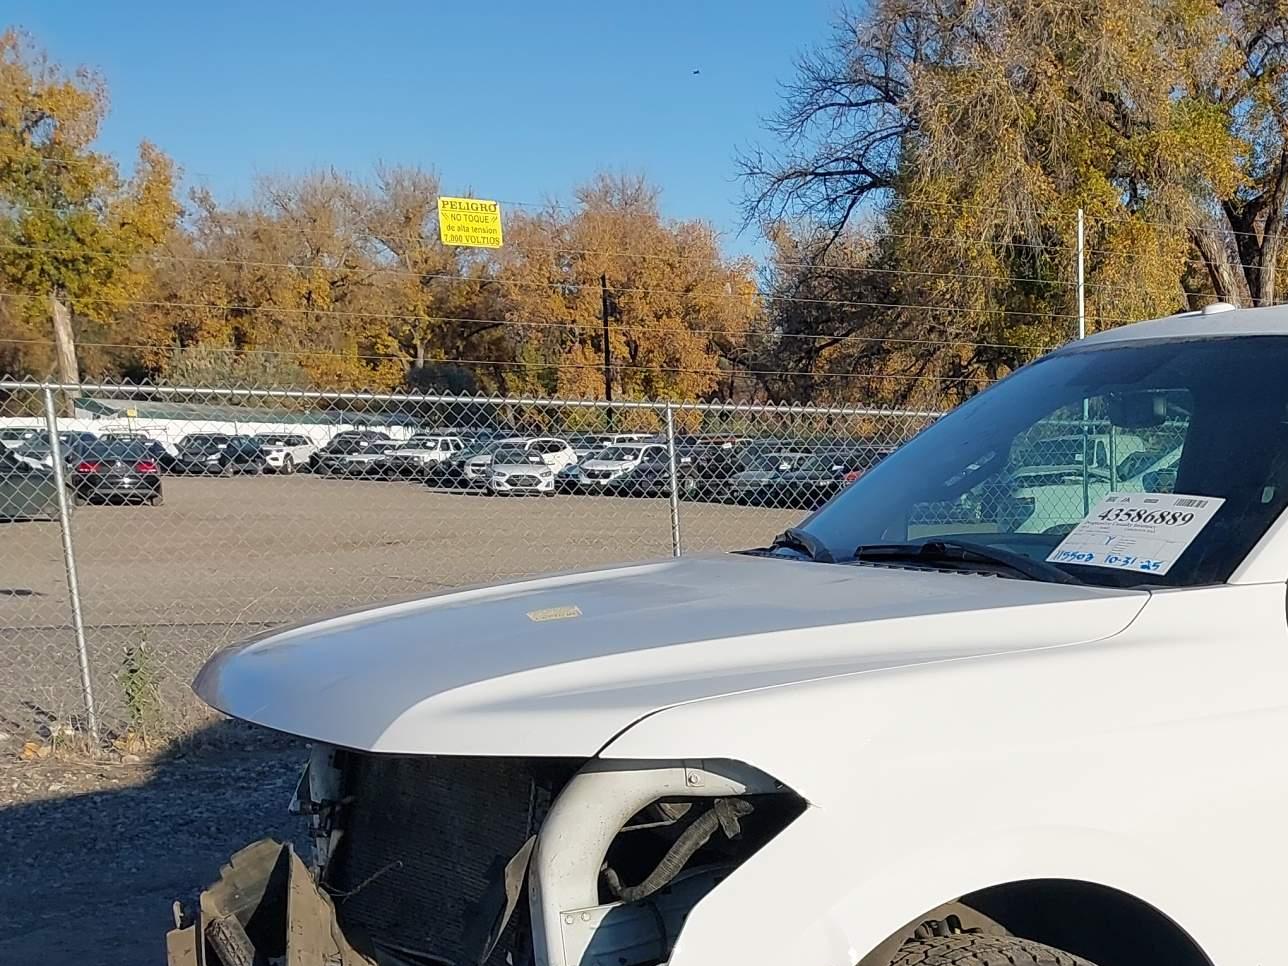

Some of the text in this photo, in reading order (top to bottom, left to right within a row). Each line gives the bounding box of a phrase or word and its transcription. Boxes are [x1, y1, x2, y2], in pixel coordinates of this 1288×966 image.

[442, 200, 497, 212] PELIGRO
[450, 213, 490, 223] NO TOQUE
[446, 223, 455, 231] de
[464, 234, 500, 246] VOLTIOS
[1098, 507, 1194, 527] 43586889
